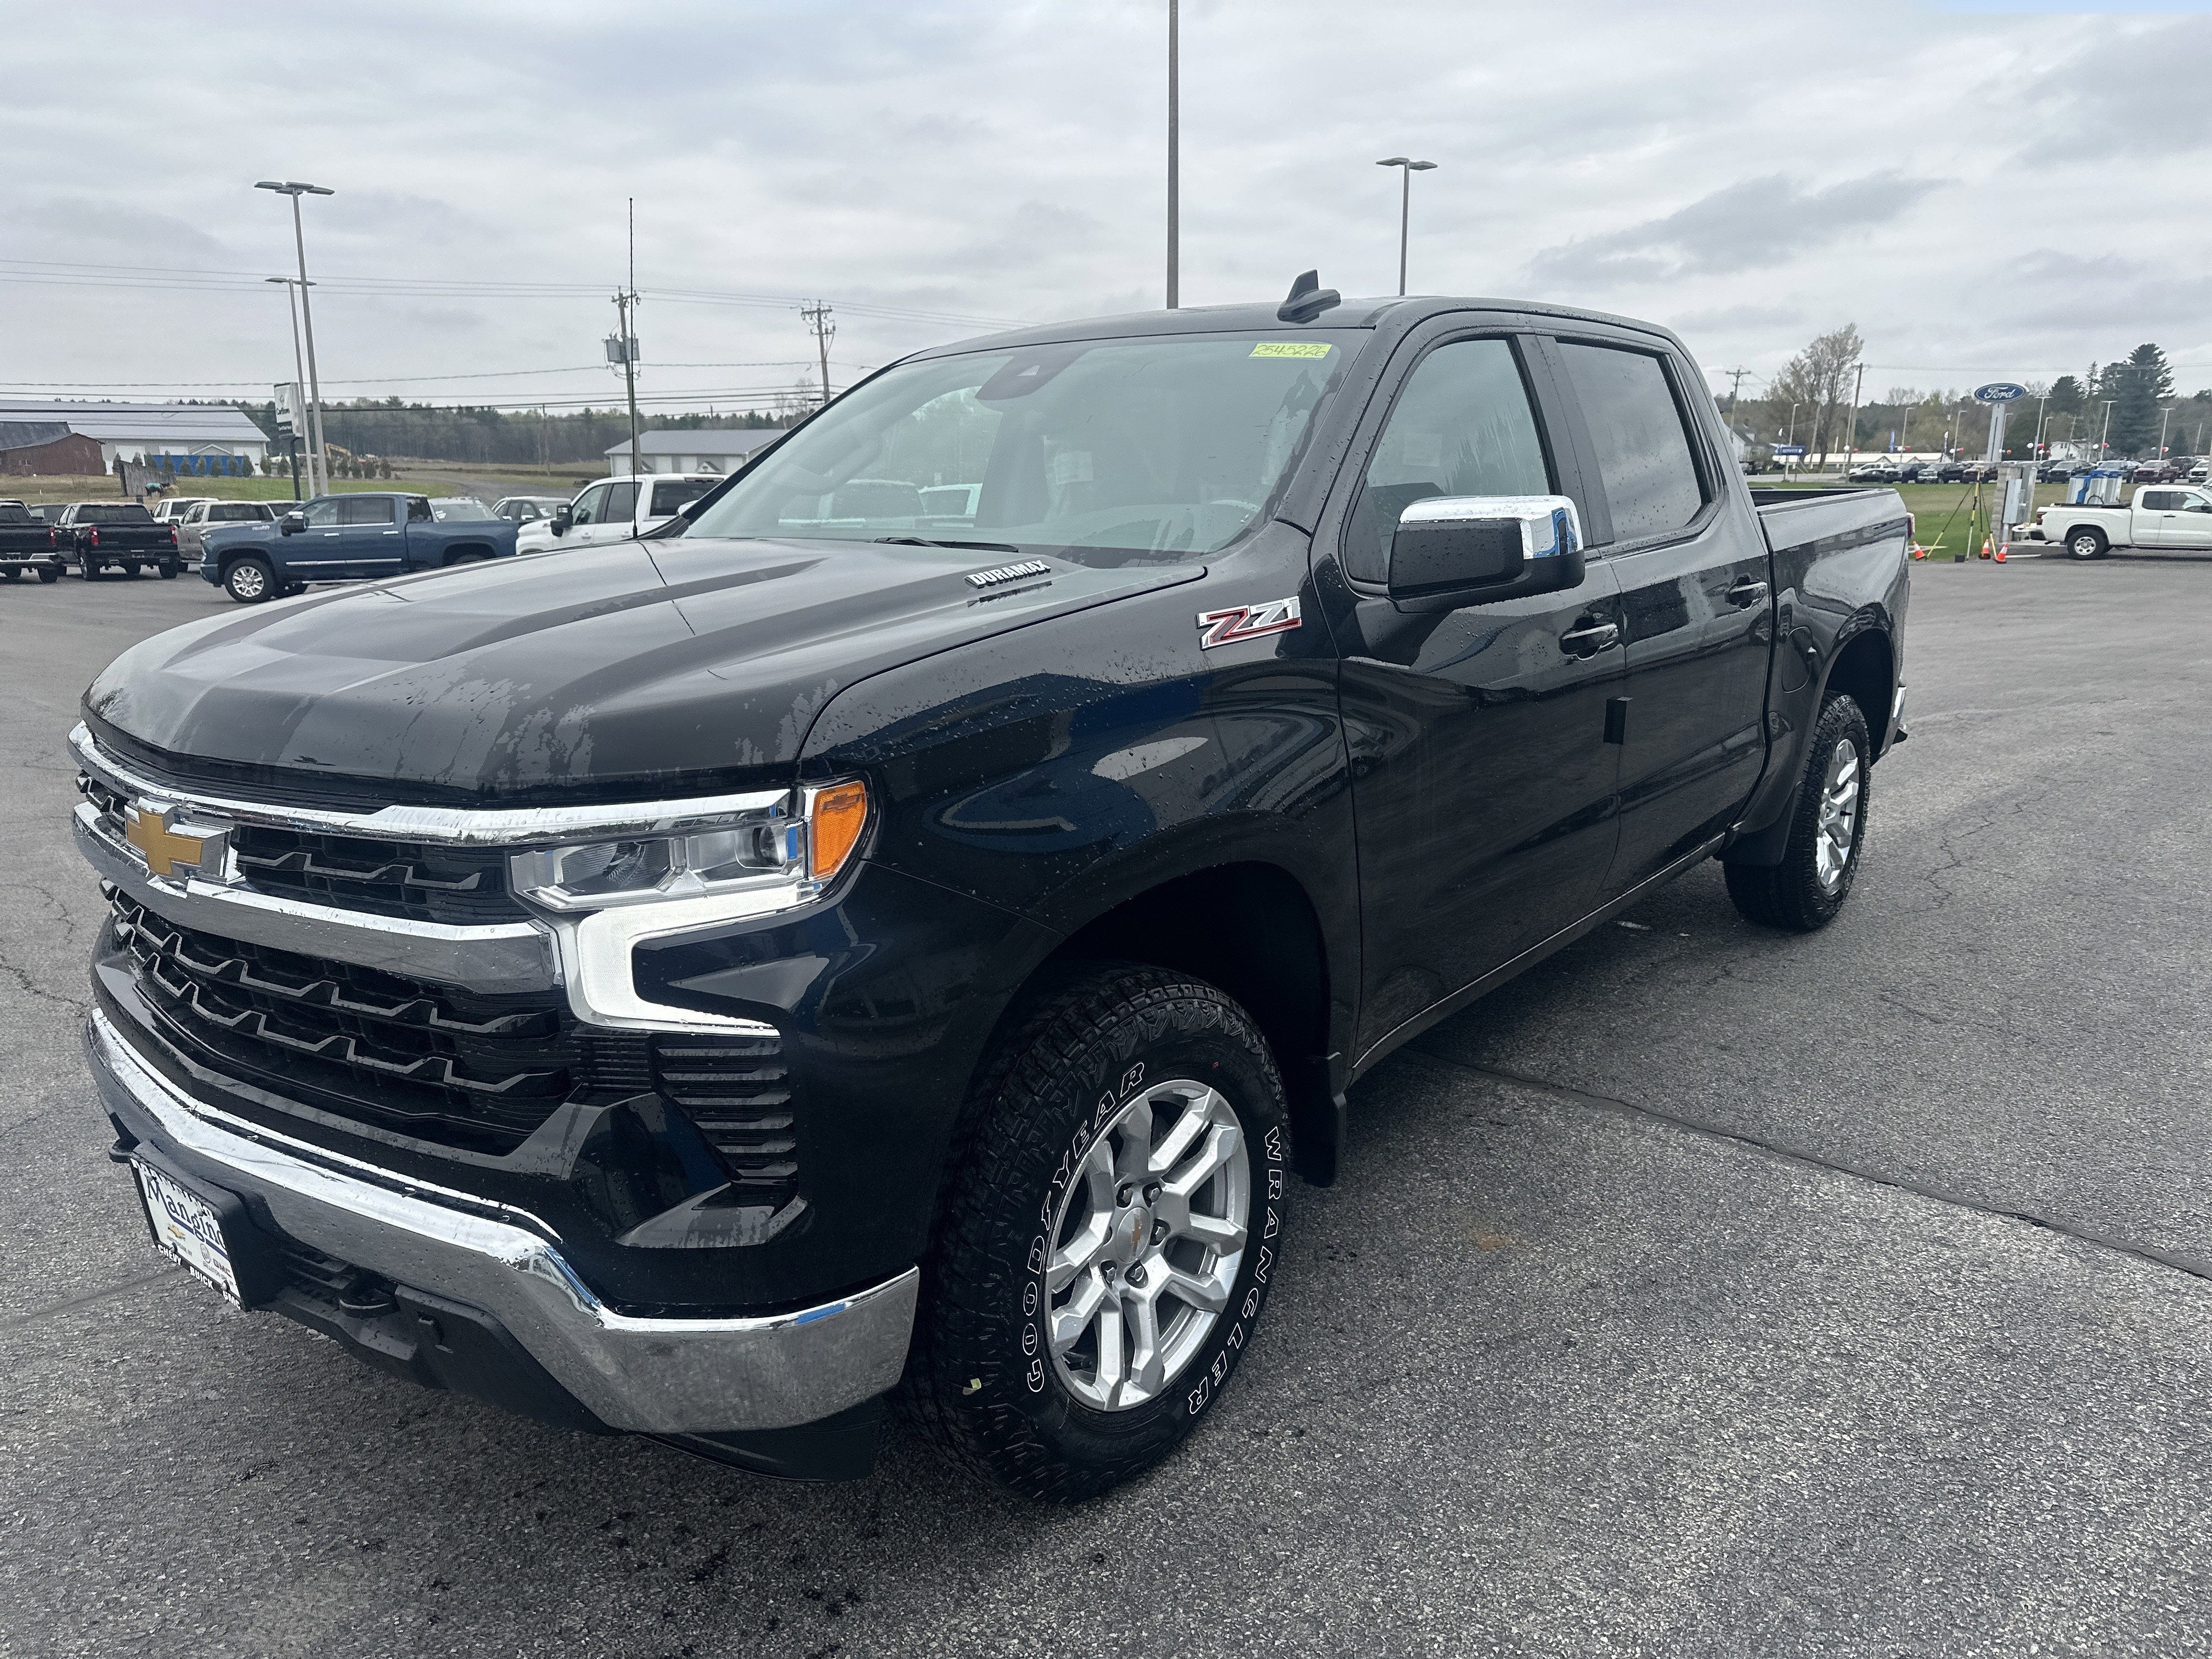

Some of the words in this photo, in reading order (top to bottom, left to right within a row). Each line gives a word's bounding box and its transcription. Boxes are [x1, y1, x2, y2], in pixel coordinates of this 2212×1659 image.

[1252, 344, 1326, 357] 2545226
[1984, 386, 2016, 399] Ford
[964, 560, 1051, 587] DURAMAX
[1196, 595, 1302, 650] Z71
[1023, 1062, 1145, 1392] GOODYEAR
[157, 1244, 182, 1266] CHEVY
[189, 1266, 215, 1290] BUICK
[1189, 1126, 1282, 1414] WRANGLER
[222, 1290, 241, 1311] GMC
